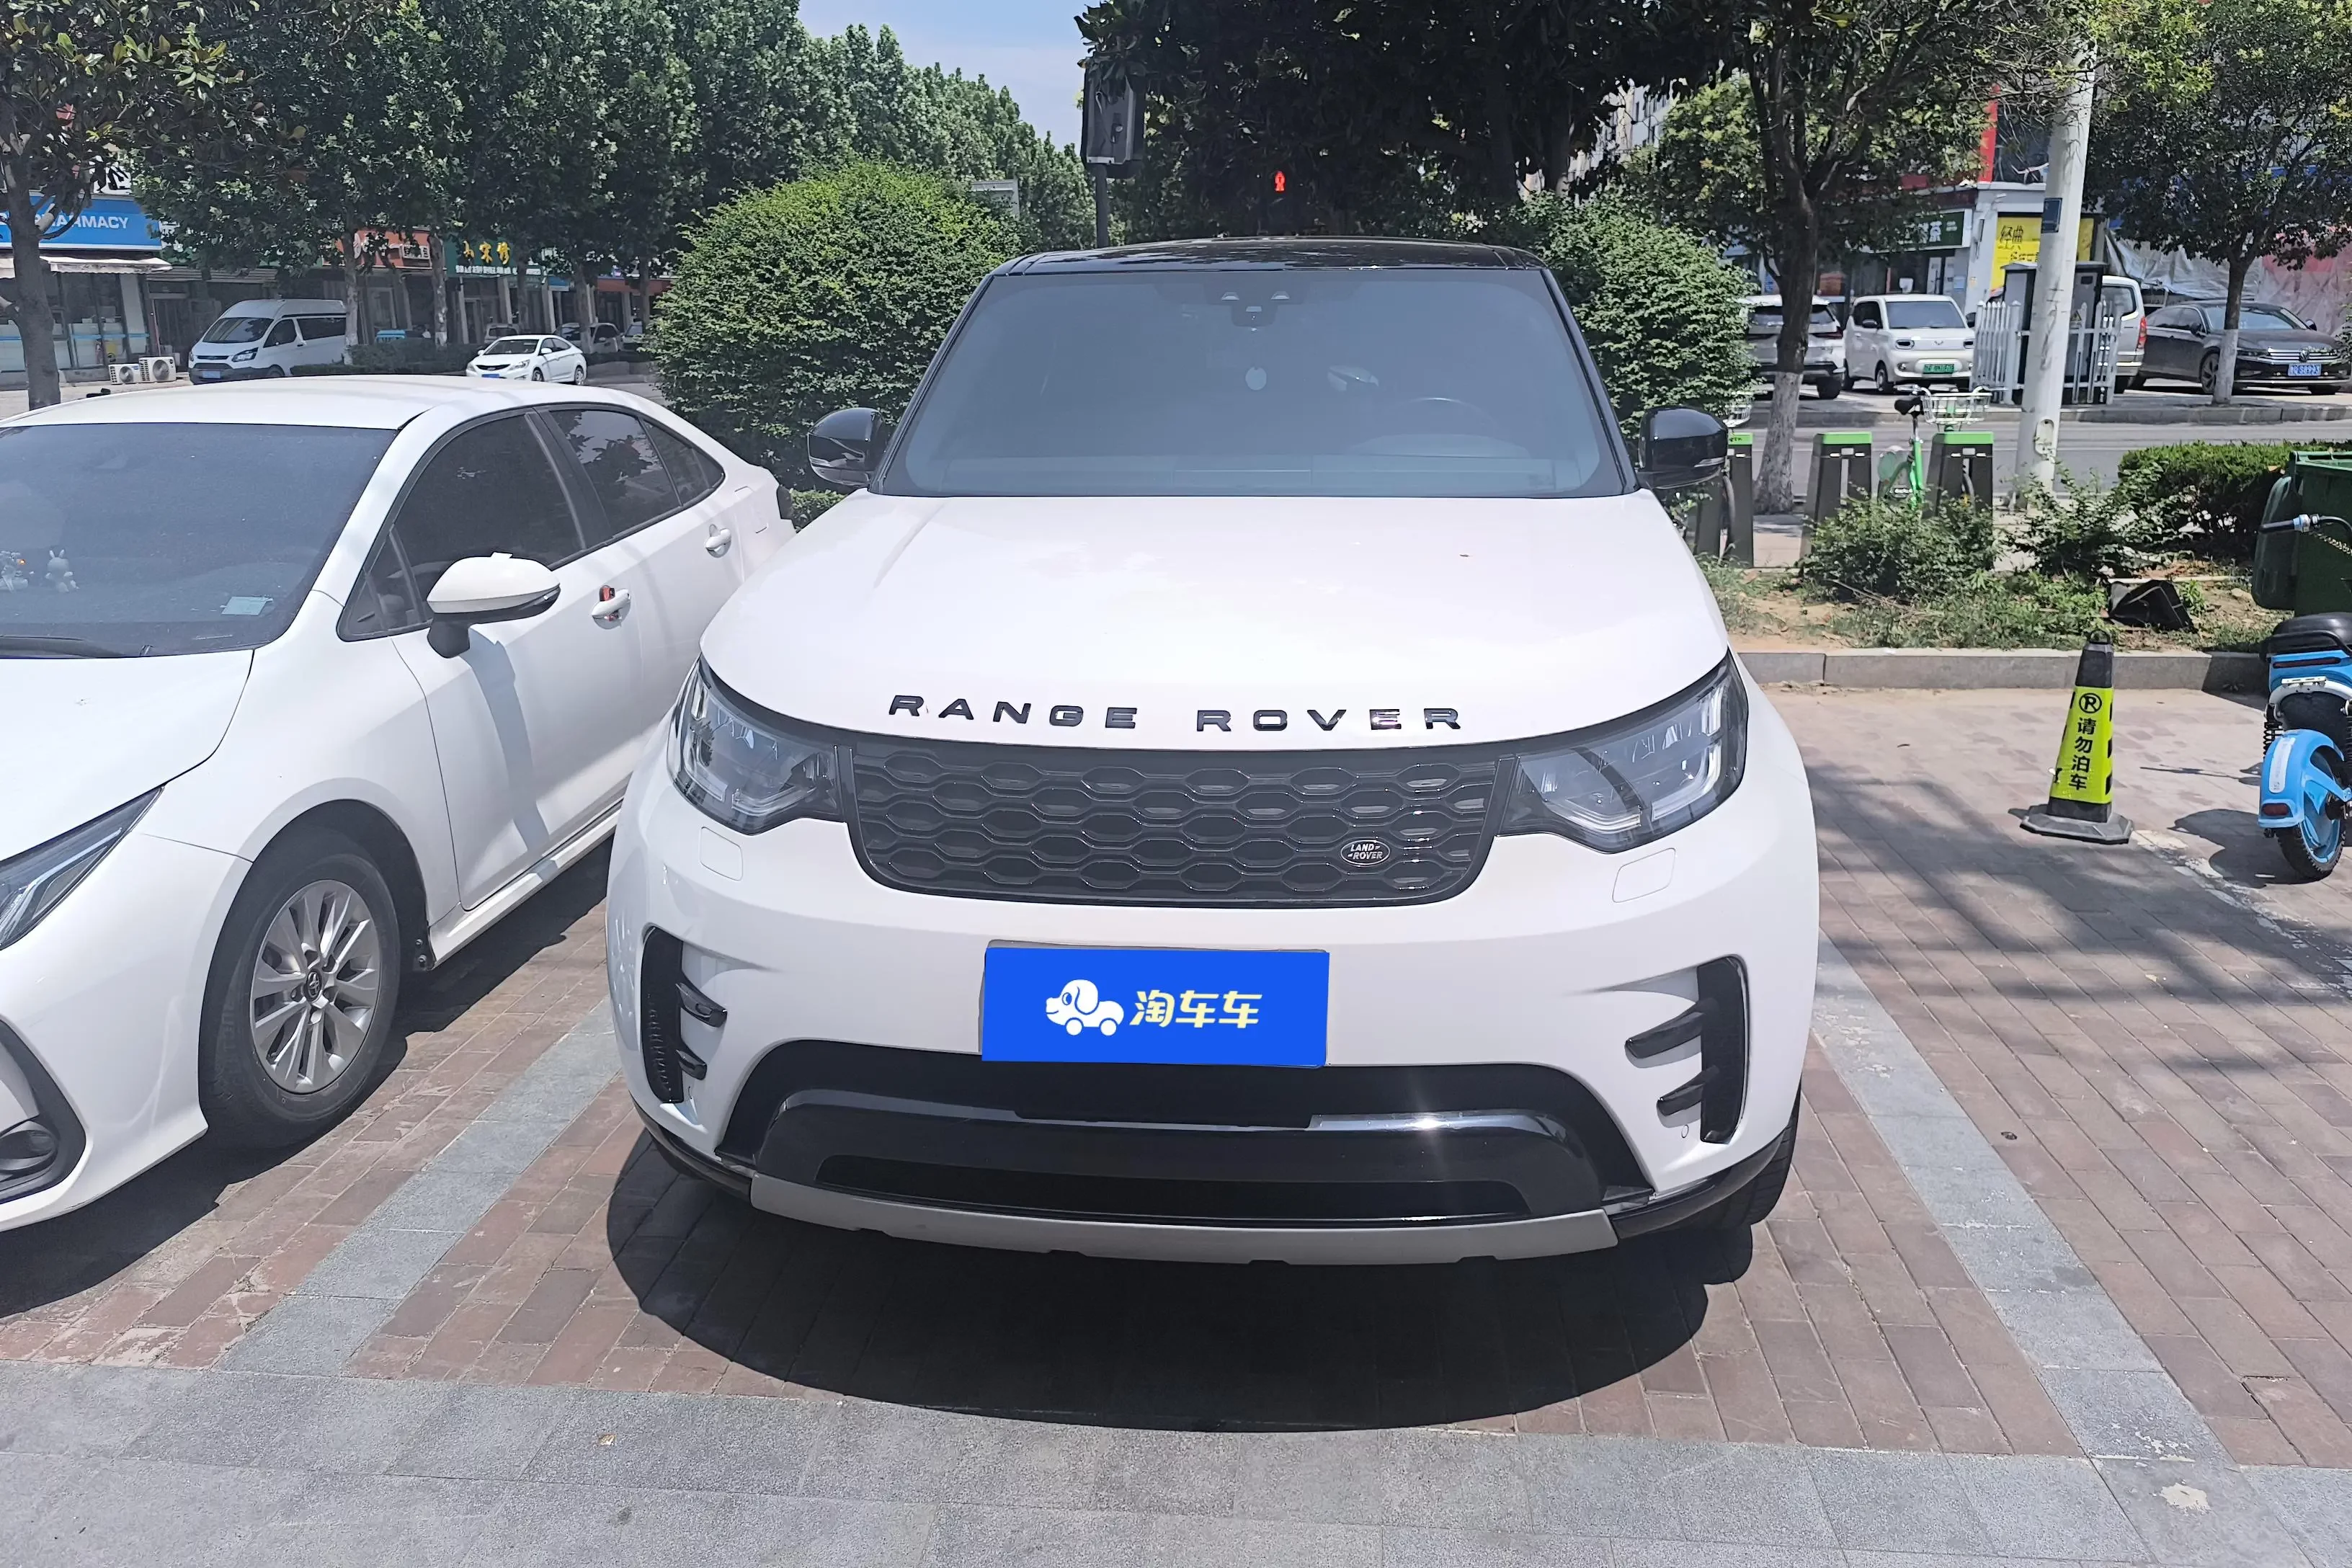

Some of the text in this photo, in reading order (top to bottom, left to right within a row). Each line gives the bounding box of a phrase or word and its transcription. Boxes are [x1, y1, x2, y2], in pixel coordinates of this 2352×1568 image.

[34, 214, 128, 229] PARMACY
[888, 694, 1461, 731] RANGE ROVER
[2069, 717, 2096, 790] 请勿泊车
[1350, 843, 1375, 852] LAND
[1352, 851, 1384, 860] ROVER
